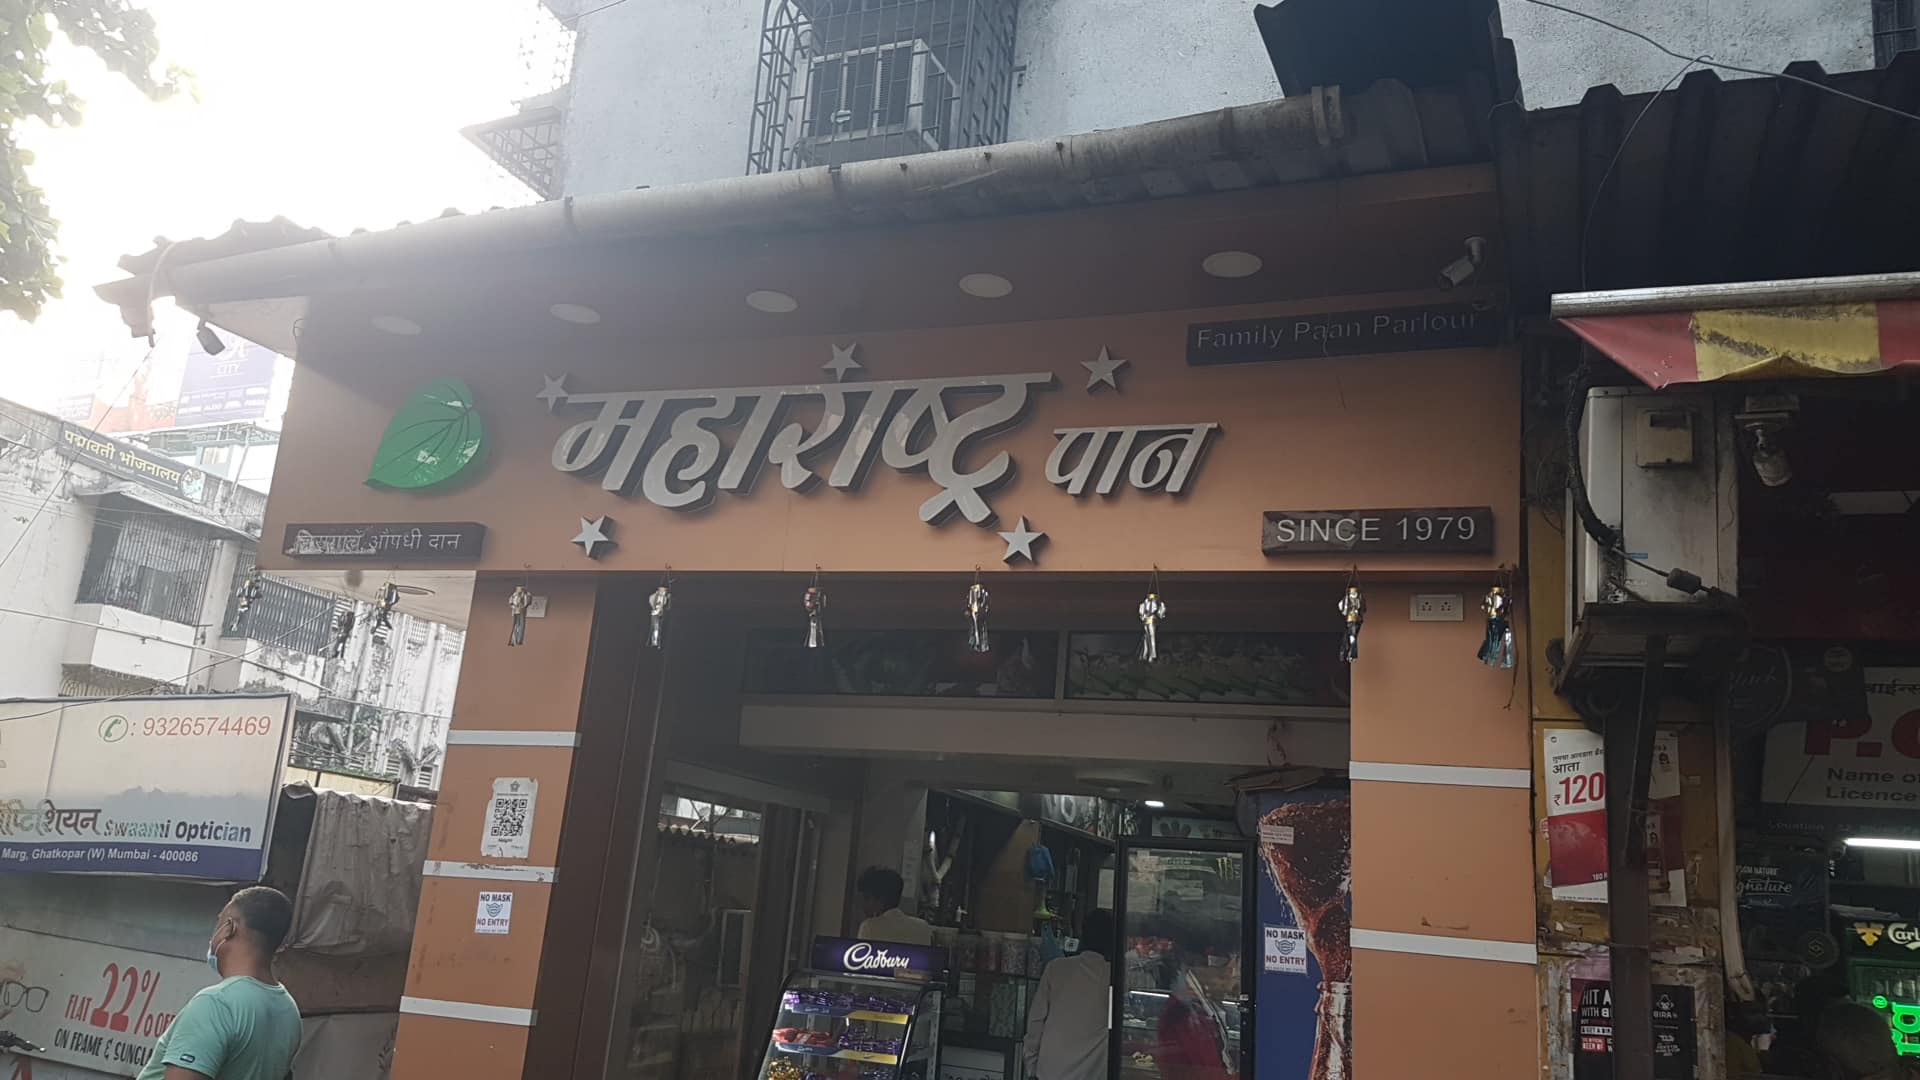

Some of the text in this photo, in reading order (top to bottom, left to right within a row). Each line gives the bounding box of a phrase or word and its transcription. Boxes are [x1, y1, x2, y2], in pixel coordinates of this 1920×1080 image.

[1196, 311, 1479, 348] Family Paan Parlour
[551, 371, 1220, 525] महाराष्ट्र पान
[119, 449, 181, 484] भोजनालय
[1276, 515, 1475, 542] SINCE 1979
[428, 534, 462, 550] दान
[142, 715, 272, 737] 9326574469
[1552, 761, 1580, 774] आता
[1826, 767, 1895, 783] Name
[104, 819, 252, 843] Swaami Optician
[32, 847, 86, 862] Ghatkopar
[87, 847, 105, 861] (W)
[108, 847, 150, 861] Mumbai
[159, 850, 199, 863] 400086
[480, 893, 511, 902] NO MASK
[476, 918, 509, 927] NO ENTRY
[1266, 930, 1305, 941] NO MASK
[843, 942, 910, 971] Cadbury
[1266, 955, 1305, 966] NO ENTRY
[64, 994, 93, 1023] FLAT
[89, 962, 160, 1038] 22%
[1582, 988, 1600, 1005] HIT
[1581, 1007, 1600, 1017] WITH
[54, 1028, 69, 1048] ON
[71, 1032, 104, 1057] FRAME
